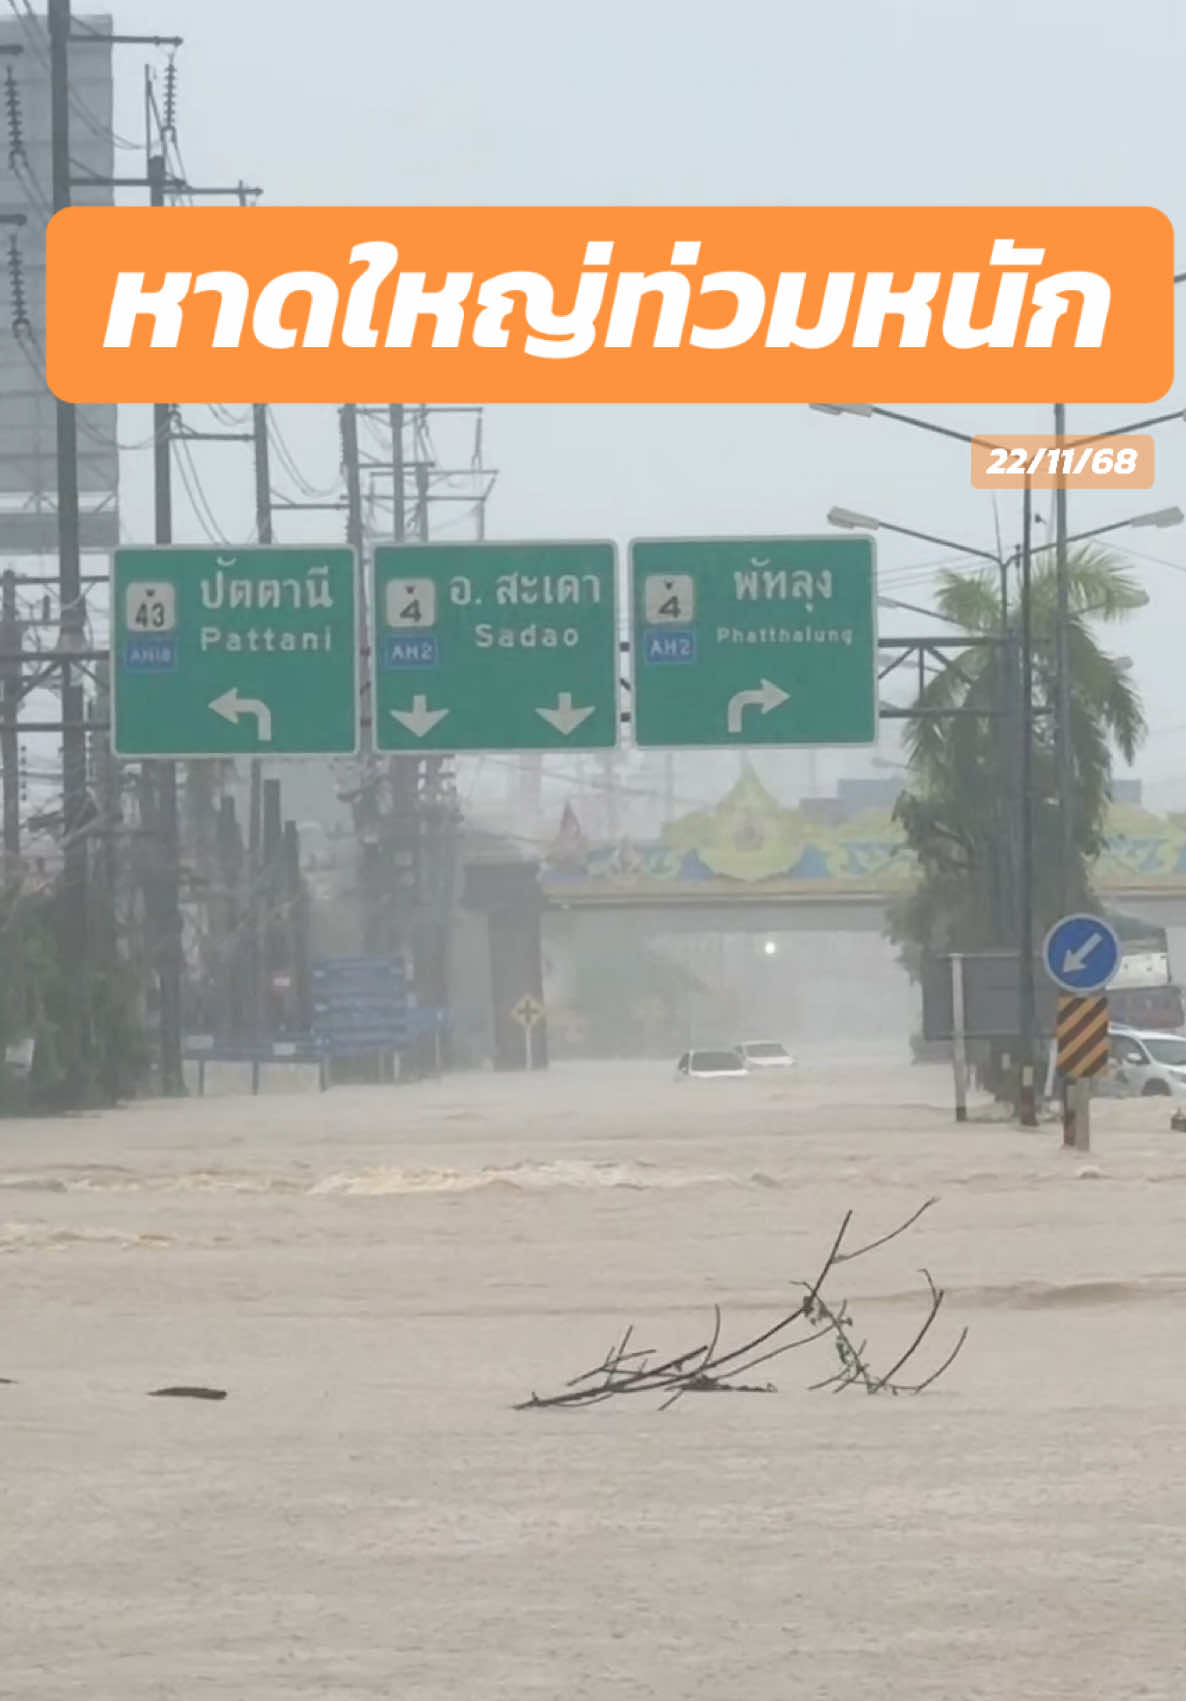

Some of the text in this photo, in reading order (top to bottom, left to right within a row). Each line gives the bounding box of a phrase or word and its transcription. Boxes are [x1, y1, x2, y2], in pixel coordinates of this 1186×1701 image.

[199, 556, 334, 610] ปัตตานี
[449, 576, 484, 607] อ.
[733, 557, 833, 613] พัทลุง
[135, 602, 166, 629] 43
[399, 599, 422, 623] 4
[658, 595, 682, 619] 4
[200, 627, 332, 652] Pattani
[474, 623, 580, 649] Sadao
[649, 640, 692, 655] AH2
[716, 626, 855, 645] Phatthalung
[391, 645, 434, 660] AH2
